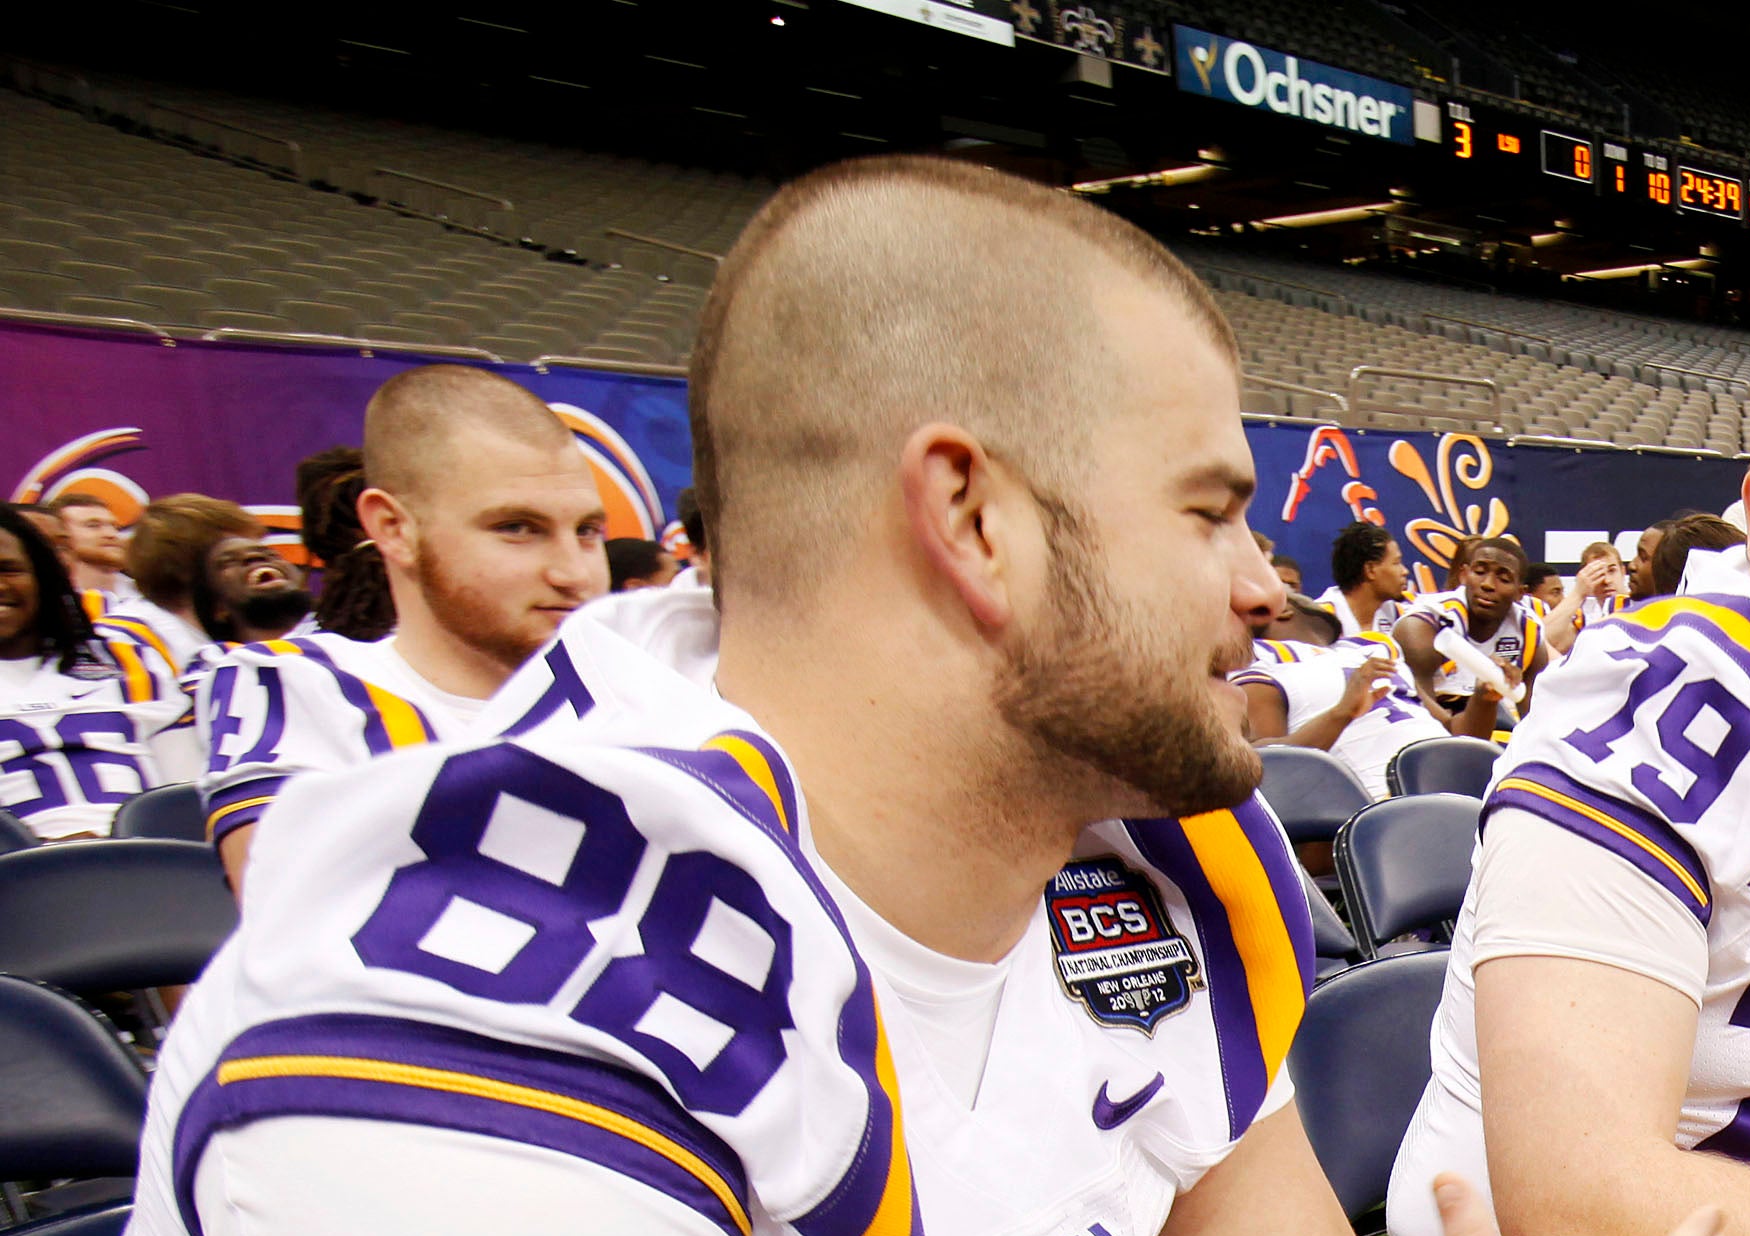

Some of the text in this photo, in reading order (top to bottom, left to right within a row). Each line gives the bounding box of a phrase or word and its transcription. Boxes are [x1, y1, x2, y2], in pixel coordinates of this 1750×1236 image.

[1223, 41, 1397, 138] Ochsner
[1454, 122, 1472, 159] 3
[1573, 145, 1591, 179] 0
[1615, 165, 1625, 192] 1
[1648, 172, 1670, 205] 10
[1680, 171, 1741, 211] 24:39
[207, 665, 286, 773] 41
[1054, 868, 1125, 892] Allstate
[350, 742, 797, 1118] 88
[1061, 901, 1148, 942] BCS
[1067, 944, 1180, 975] NATIONAL CHAMPIONSHIP
[1096, 971, 1167, 995] NEW ORLEANS
